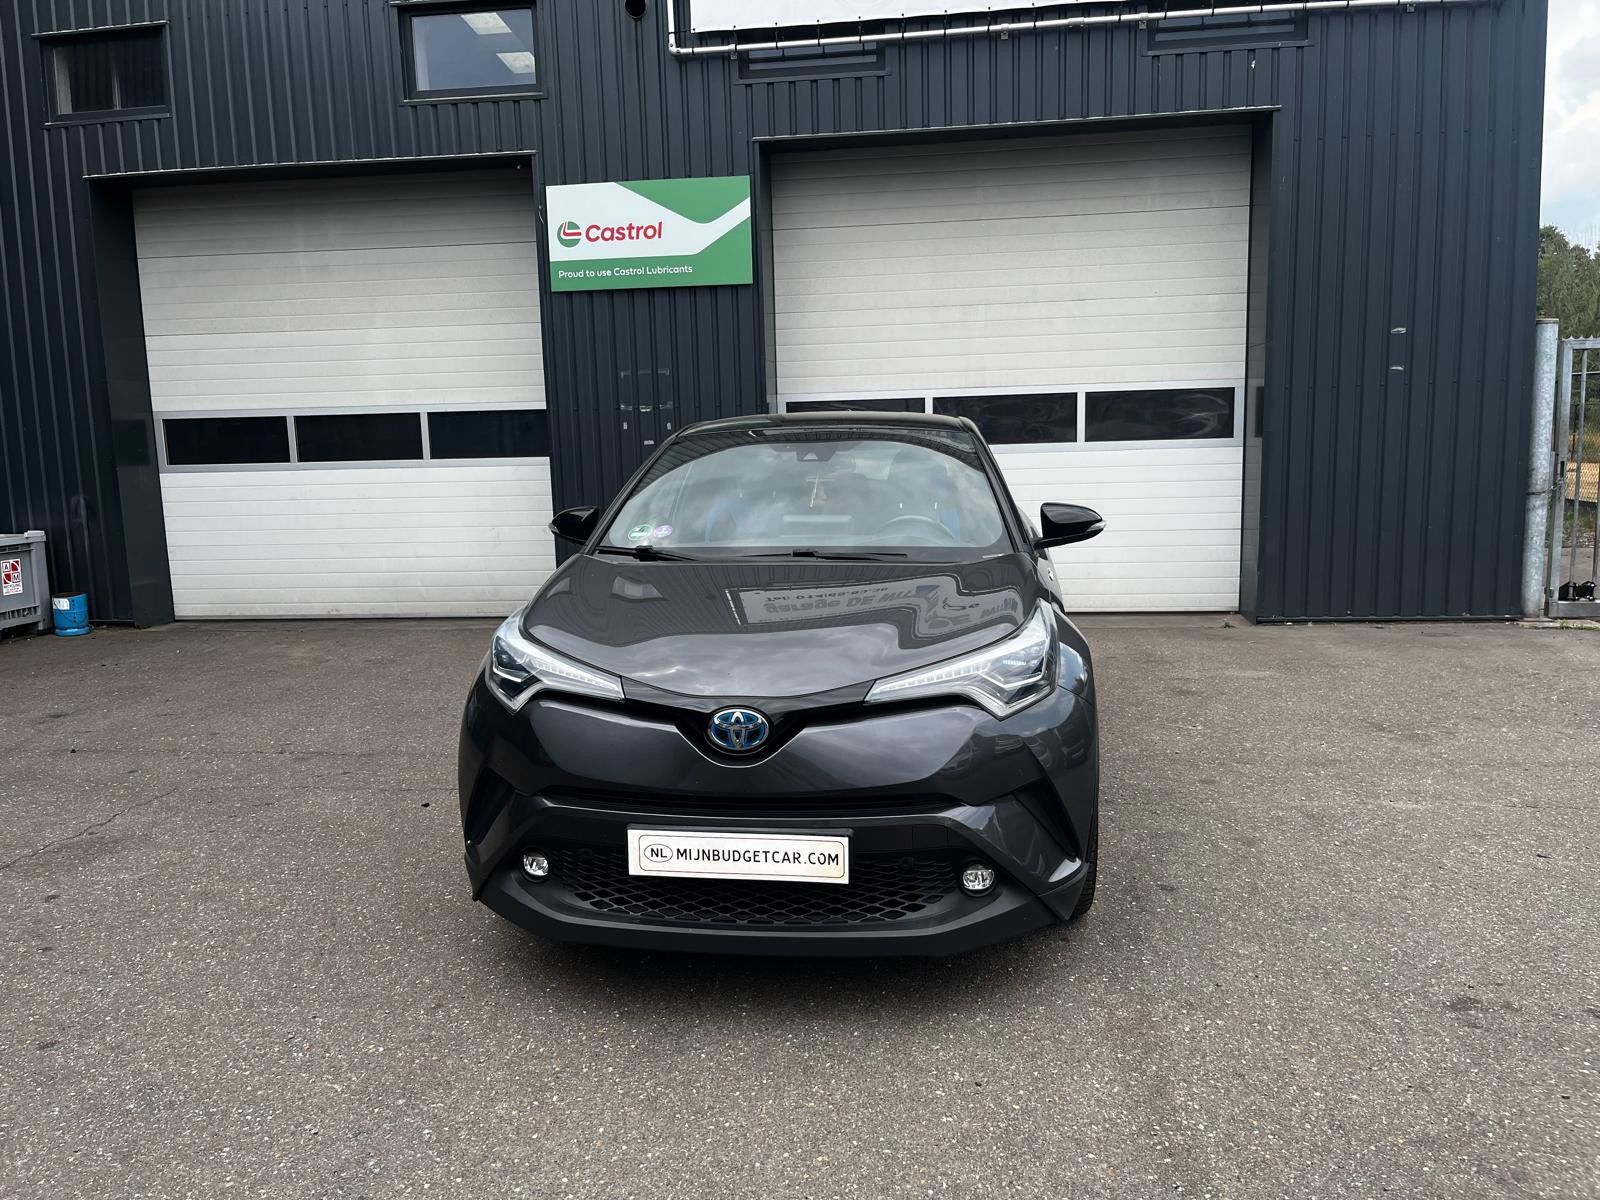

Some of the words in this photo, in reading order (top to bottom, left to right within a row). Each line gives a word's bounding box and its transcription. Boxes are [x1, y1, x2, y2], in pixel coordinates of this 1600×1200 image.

[585, 221, 663, 242] Castrol
[558, 269, 585, 279] Proud
[586, 269, 596, 277] to
[597, 268, 612, 277] use
[613, 266, 645, 276] Castrol
[646, 264, 693, 275] Lubricants
[650, 847, 668, 858] NL
[676, 847, 839, 866] MIJNBUDGETCAR.COM
